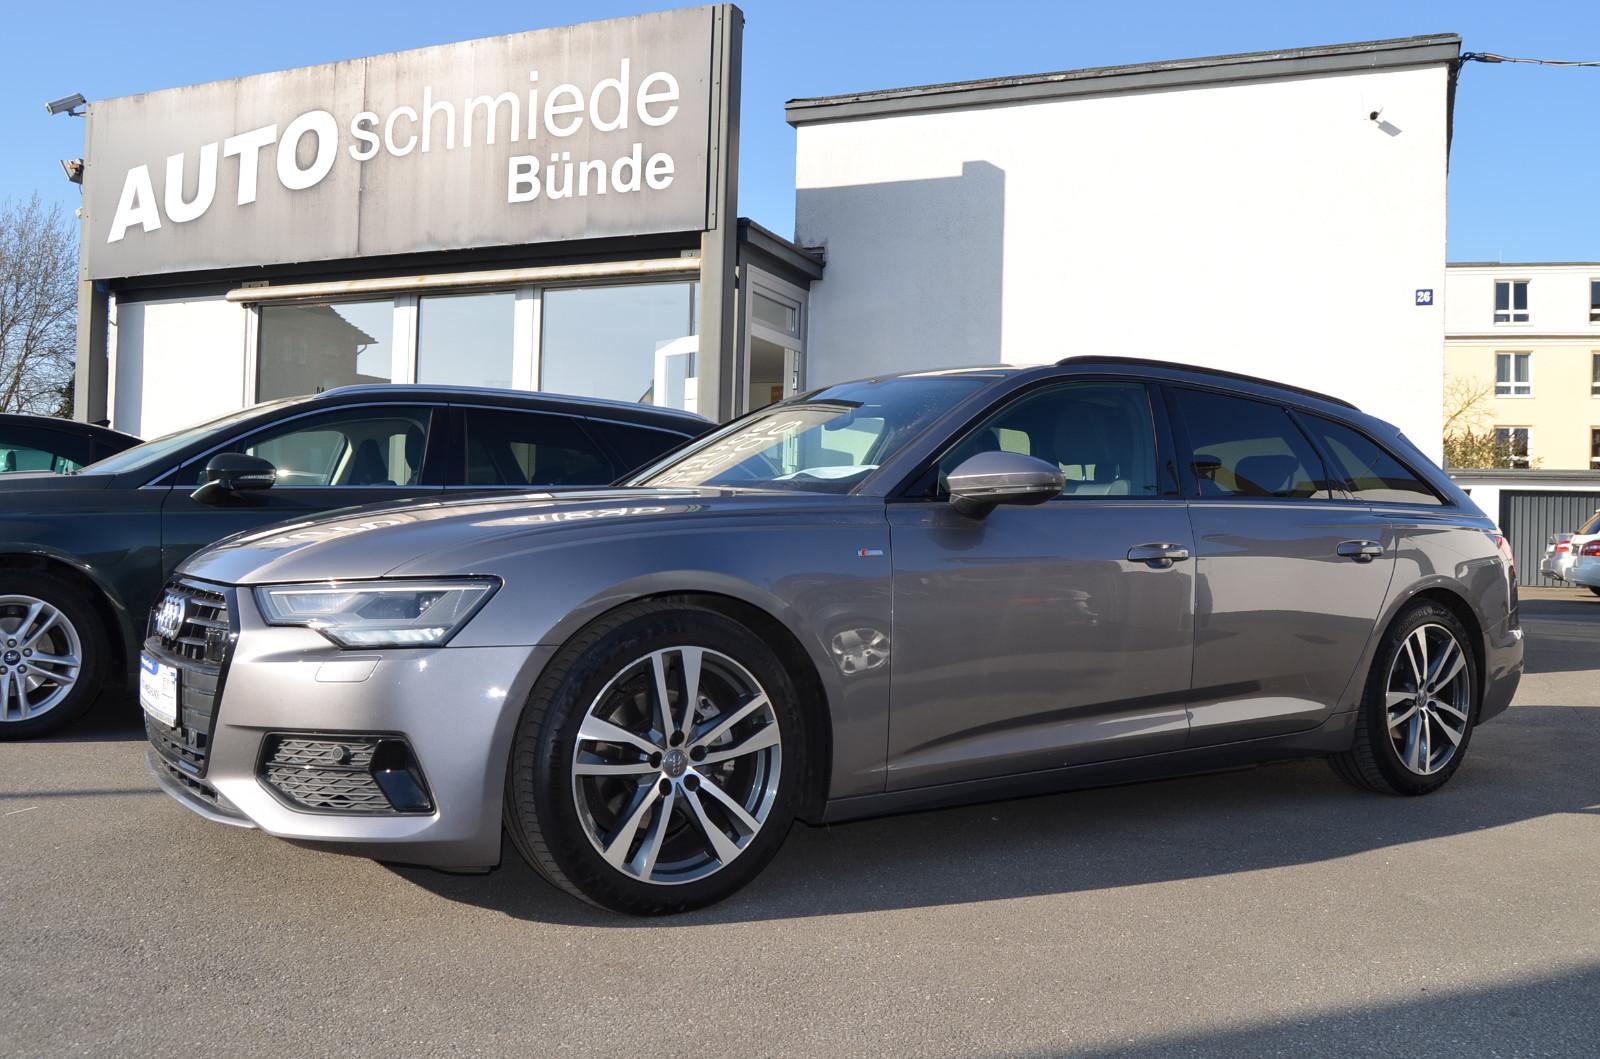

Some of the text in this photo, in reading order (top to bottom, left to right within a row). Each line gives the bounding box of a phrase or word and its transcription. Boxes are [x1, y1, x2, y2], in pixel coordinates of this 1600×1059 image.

[107, 57, 680, 243] AUTO schmiede
[508, 142, 675, 204] Bünde
